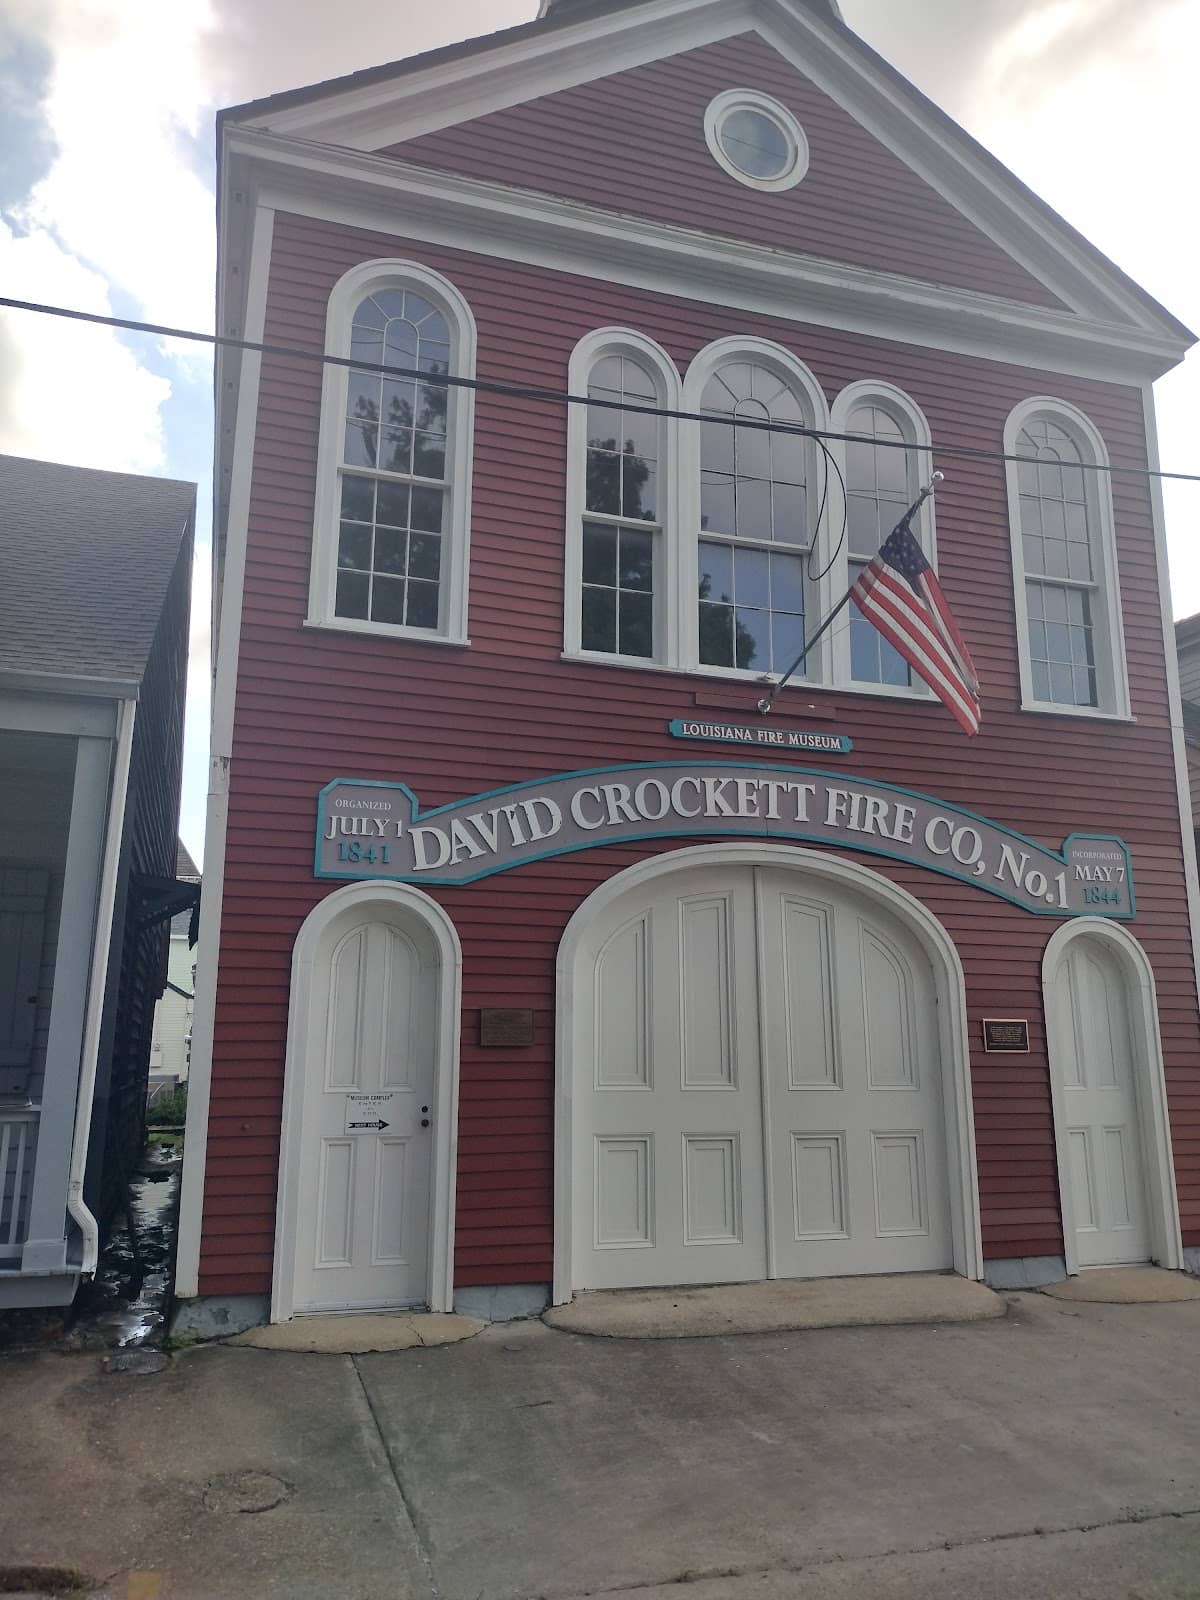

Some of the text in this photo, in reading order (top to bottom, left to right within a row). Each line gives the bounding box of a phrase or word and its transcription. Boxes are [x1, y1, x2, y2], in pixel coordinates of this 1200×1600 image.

[682, 723, 841, 749] LOUISIANA FIRE MUSEUM
[335, 799, 391, 810] ORGANIZED
[324, 815, 403, 840] JULY 1
[407, 797, 562, 871] DAVID
[571, 776, 815, 830] CROCKETT
[823, 785, 917, 844] FIRE
[337, 840, 391, 864] 1841
[1073, 864, 1125, 882] MAY 7
[1083, 885, 1121, 904] 1844
